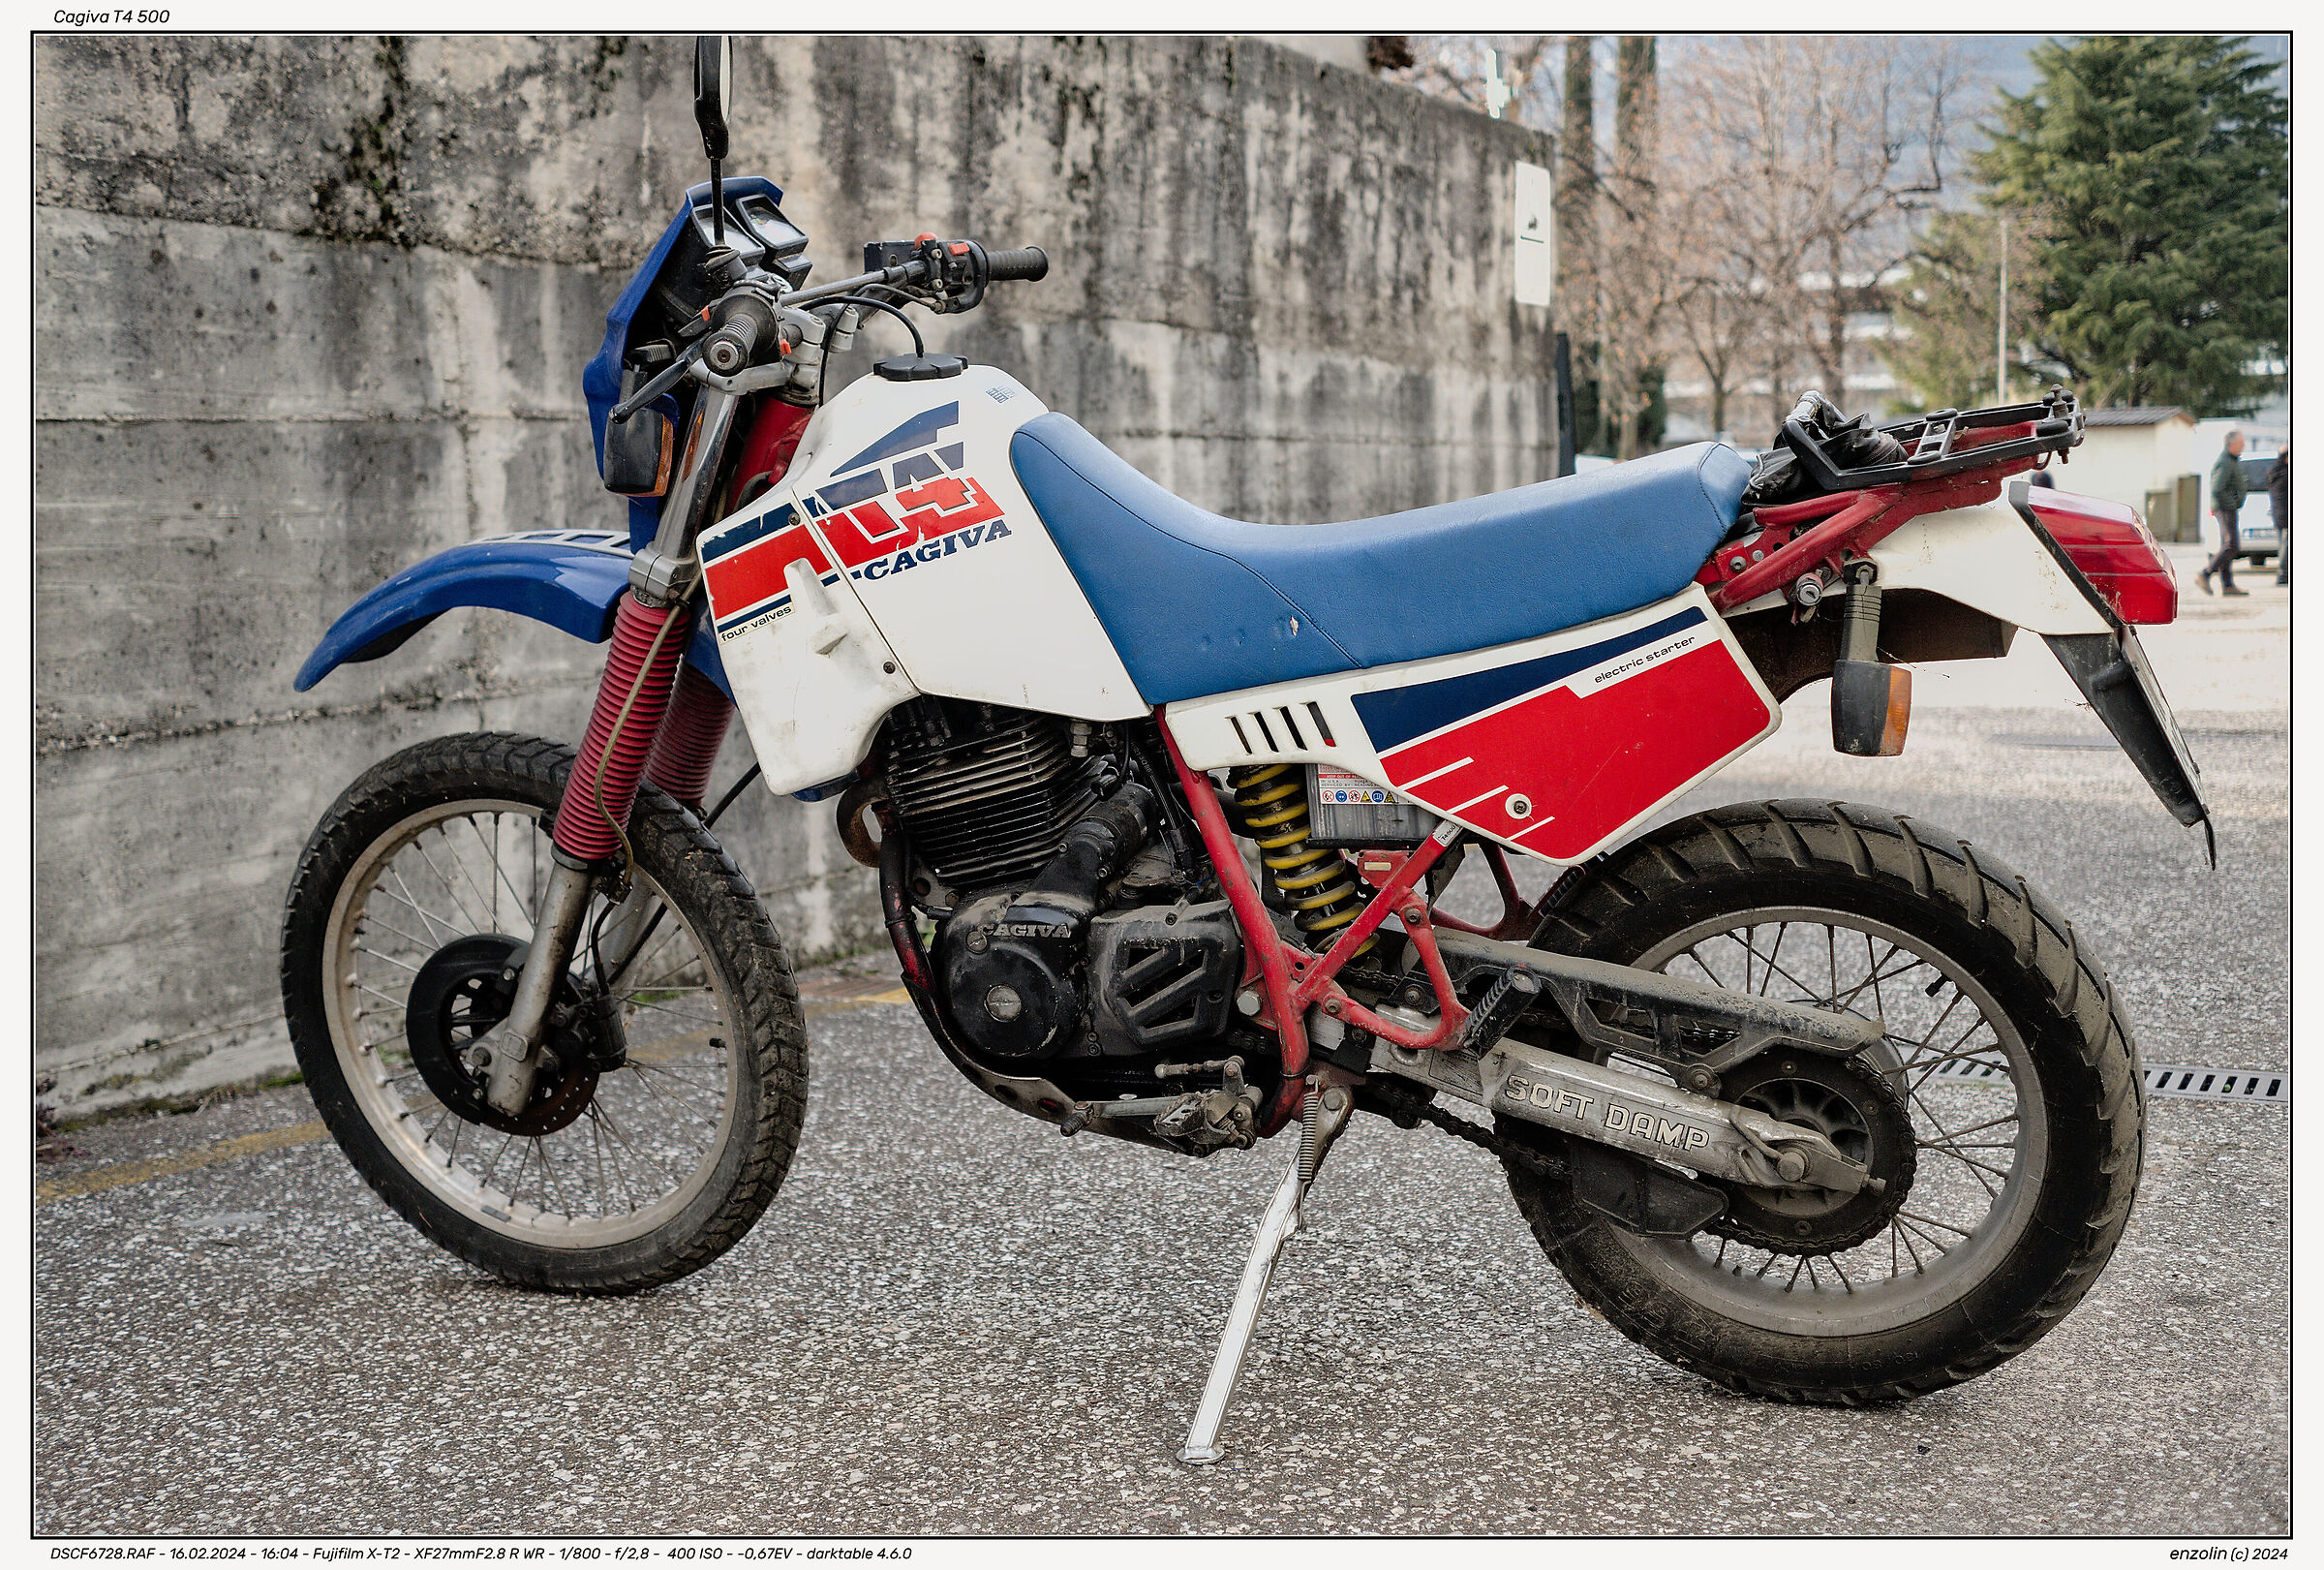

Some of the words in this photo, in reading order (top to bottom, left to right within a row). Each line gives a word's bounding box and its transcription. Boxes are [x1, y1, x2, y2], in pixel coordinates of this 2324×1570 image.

[863, 518, 1013, 581] CAGIVA
[720, 625, 749, 642] four
[750, 606, 792, 629] valves
[1594, 659, 1644, 684] electric
[1645, 636, 1696, 662] starter
[977, 923, 1072, 939] CAGIVA
[1504, 1073, 1595, 1121] SOFT
[1604, 1102, 1711, 1152] DAMP
